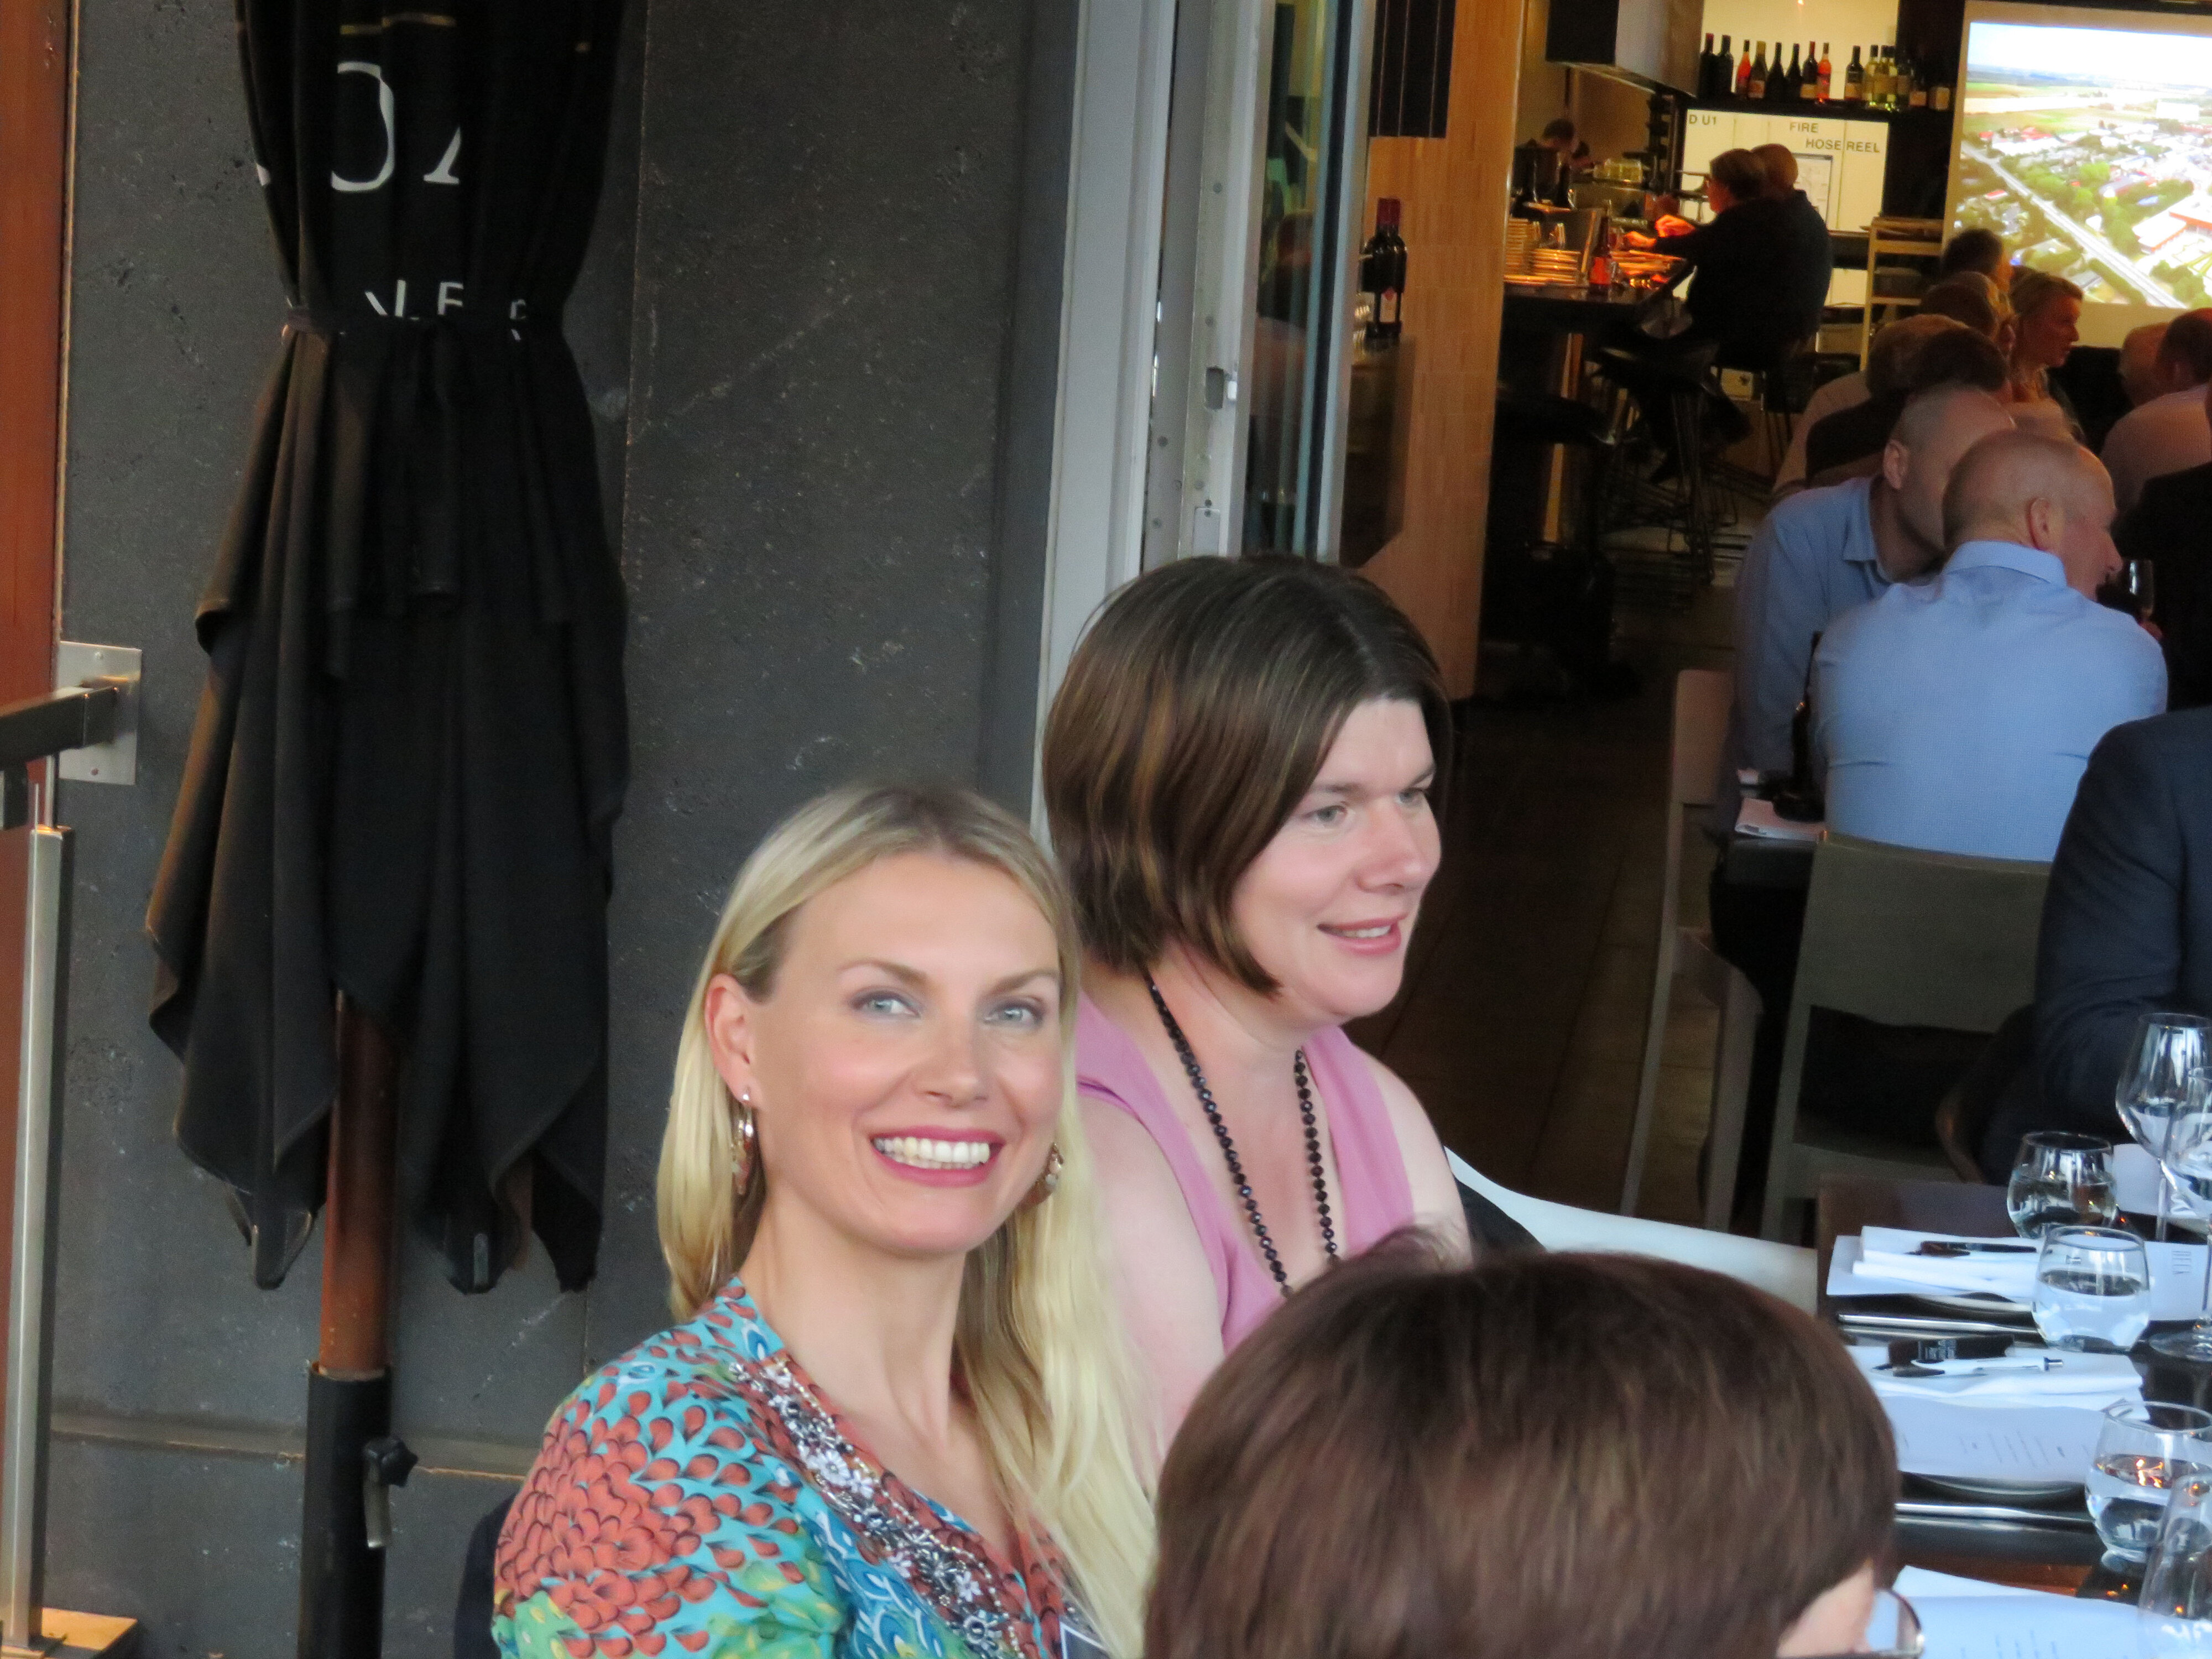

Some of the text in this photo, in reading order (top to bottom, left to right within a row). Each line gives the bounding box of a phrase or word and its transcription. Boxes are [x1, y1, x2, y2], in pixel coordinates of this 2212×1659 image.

[1790, 122, 1819, 133] FIRE
[1806, 138, 1880, 153] HOSE REEL
